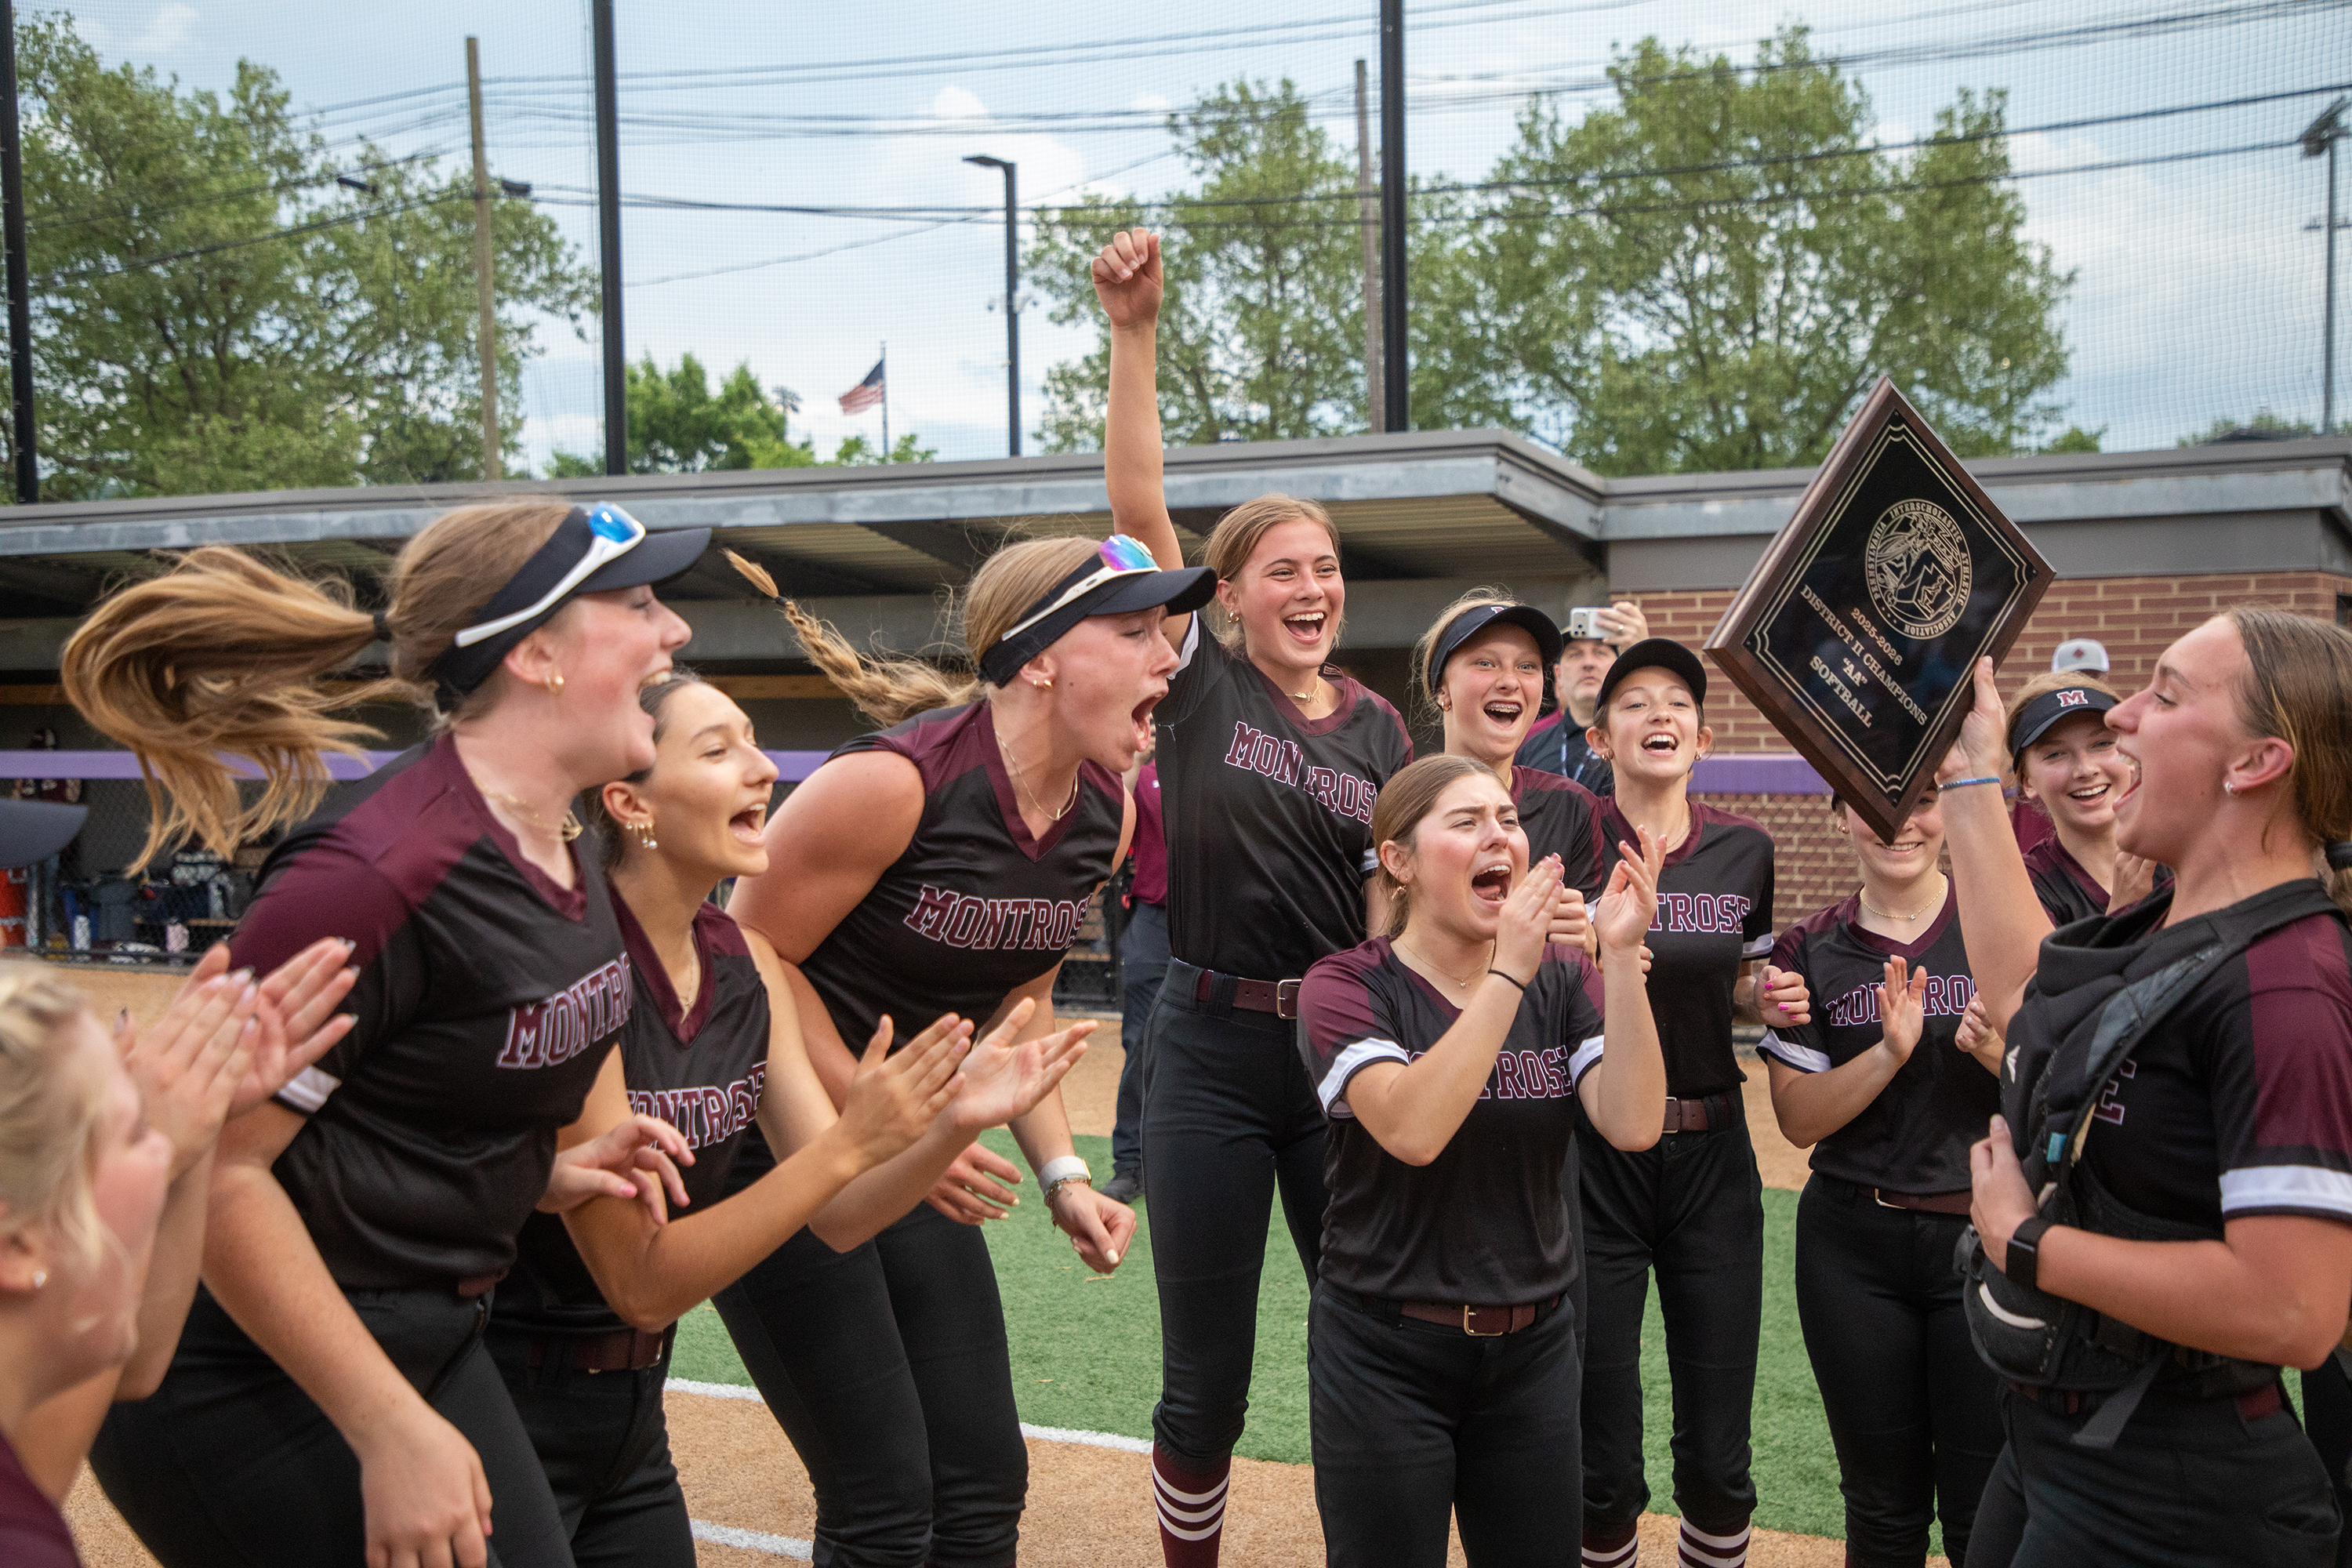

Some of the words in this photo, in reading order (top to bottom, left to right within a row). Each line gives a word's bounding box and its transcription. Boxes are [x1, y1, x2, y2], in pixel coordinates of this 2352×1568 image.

[1889, 503, 1962, 543] INTERSCHOLASTIC
[1867, 521, 1887, 601] PENNSYLVANIA
[1958, 552, 1971, 607] ATHLETIC
[1850, 607, 1903, 666] 2025-2026
[1904, 610, 1957, 637] ASSOCIATION
[1800, 583, 1854, 644] DISTRICT
[1851, 640, 1865, 657] II
[1863, 652, 1928, 726] CHAMPIONS
[1809, 655, 1873, 728] SOFTBALL
[2056, 690, 2089, 707] M
